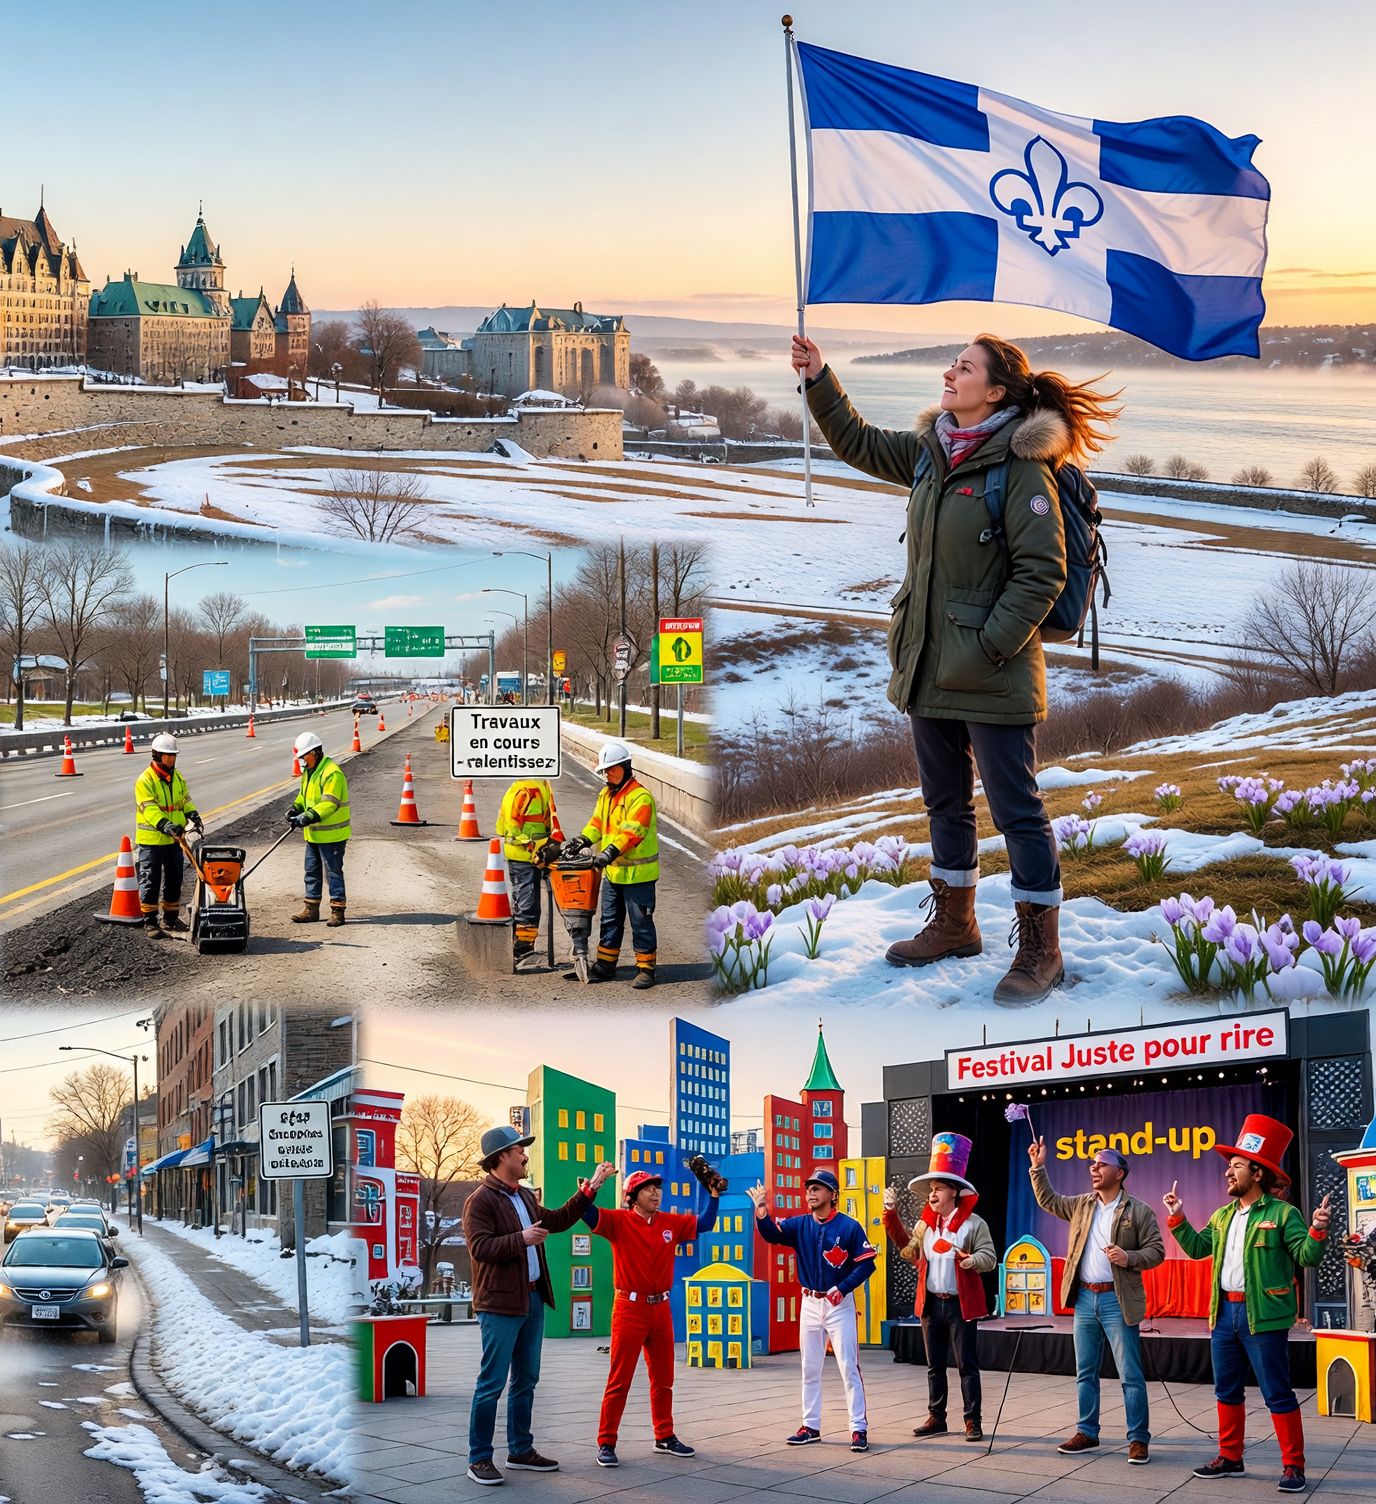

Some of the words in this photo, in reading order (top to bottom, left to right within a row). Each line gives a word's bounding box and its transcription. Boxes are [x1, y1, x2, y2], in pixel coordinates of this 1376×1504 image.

[470, 713, 541, 730] Travaux
[469, 738, 489, 749] en
[493, 738, 541, 750] cours
[466, 754, 556, 769] ralentissez
[957, 1046, 1052, 1080] Festival
[1061, 1040, 1135, 1069] Juste
[1144, 1033, 1212, 1065] pour
[1221, 1023, 1275, 1051] rire
[1055, 1121, 1217, 1160] stand-up
